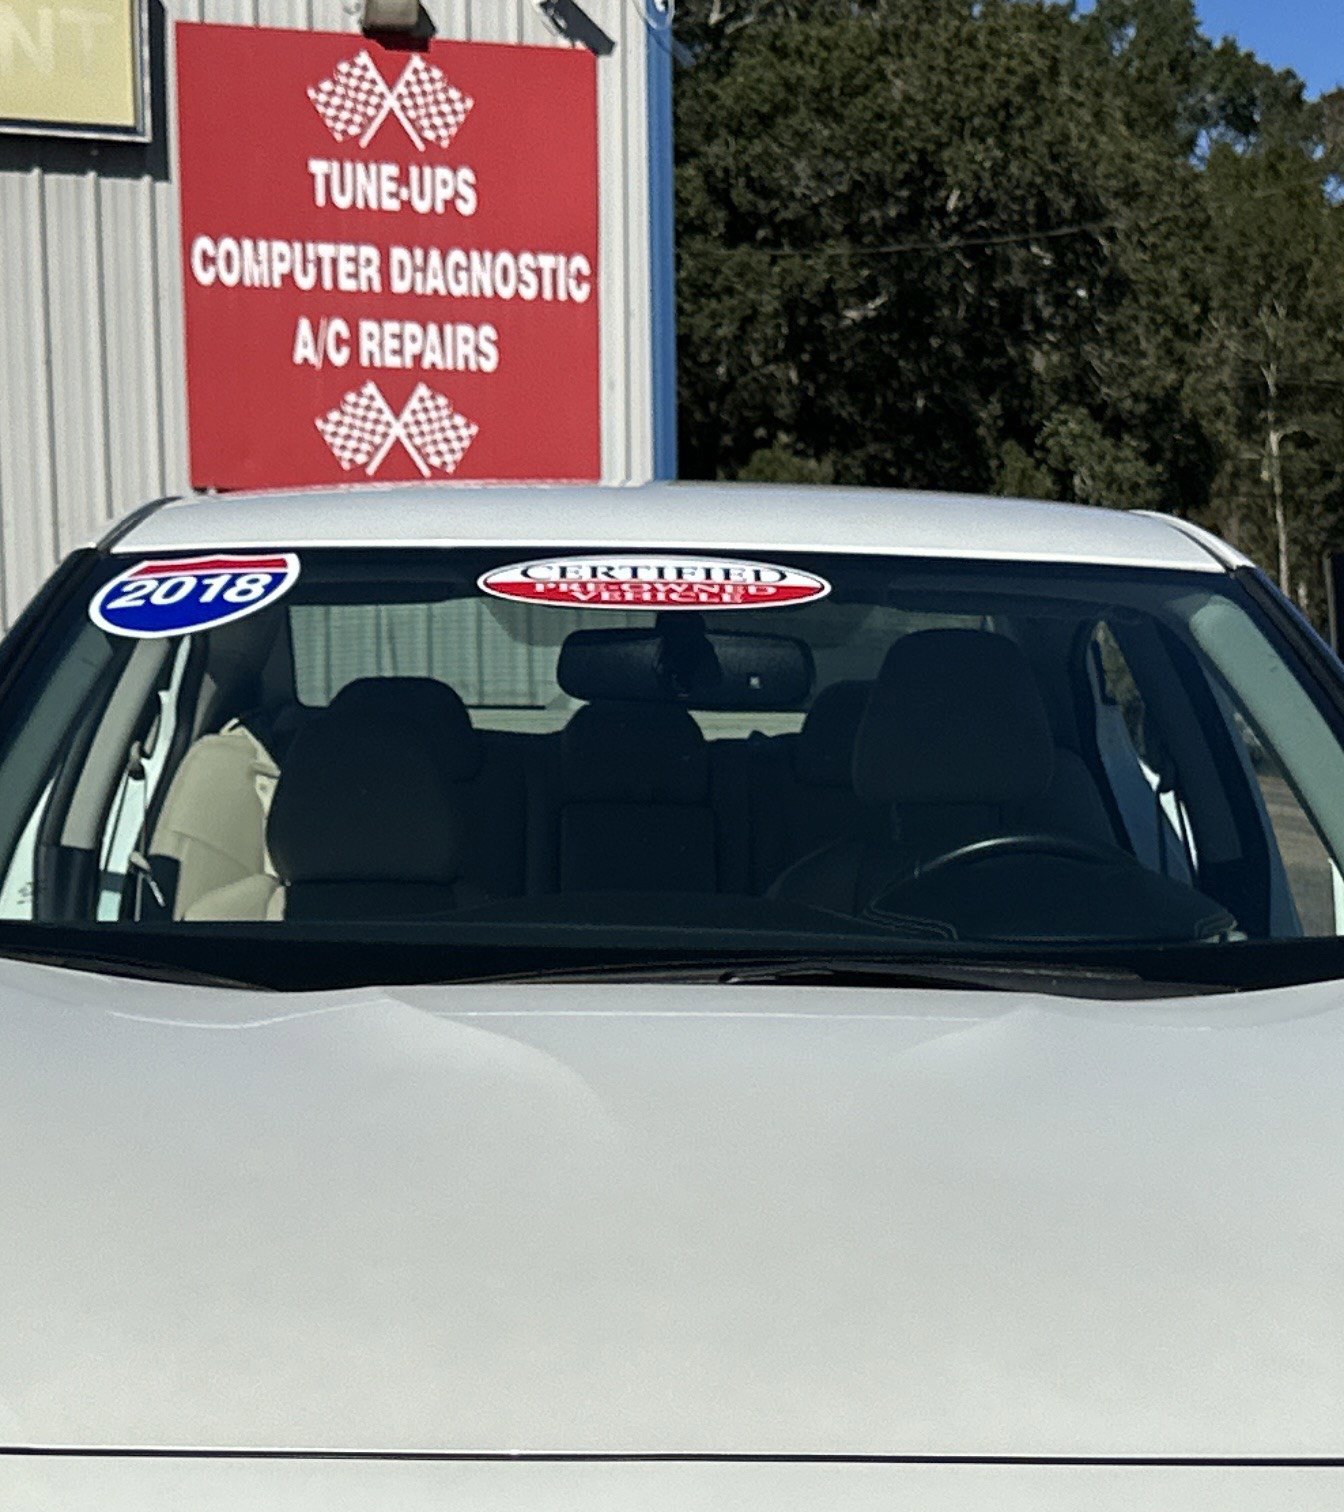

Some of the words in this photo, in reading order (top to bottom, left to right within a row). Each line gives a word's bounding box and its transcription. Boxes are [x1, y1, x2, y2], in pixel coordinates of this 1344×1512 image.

[307, 158, 477, 217] TUNE-UPS
[191, 235, 382, 293] COMPUTER
[389, 246, 592, 303] DIAGNOSTIC
[293, 315, 351, 370] A/C
[358, 319, 500, 373] REPAIRS
[106, 573, 273, 610] 2018
[520, 564, 787, 582] CERTIFIED
[534, 582, 777, 596] PRE-OWNED
[571, 590, 745, 603] VEHICLE
